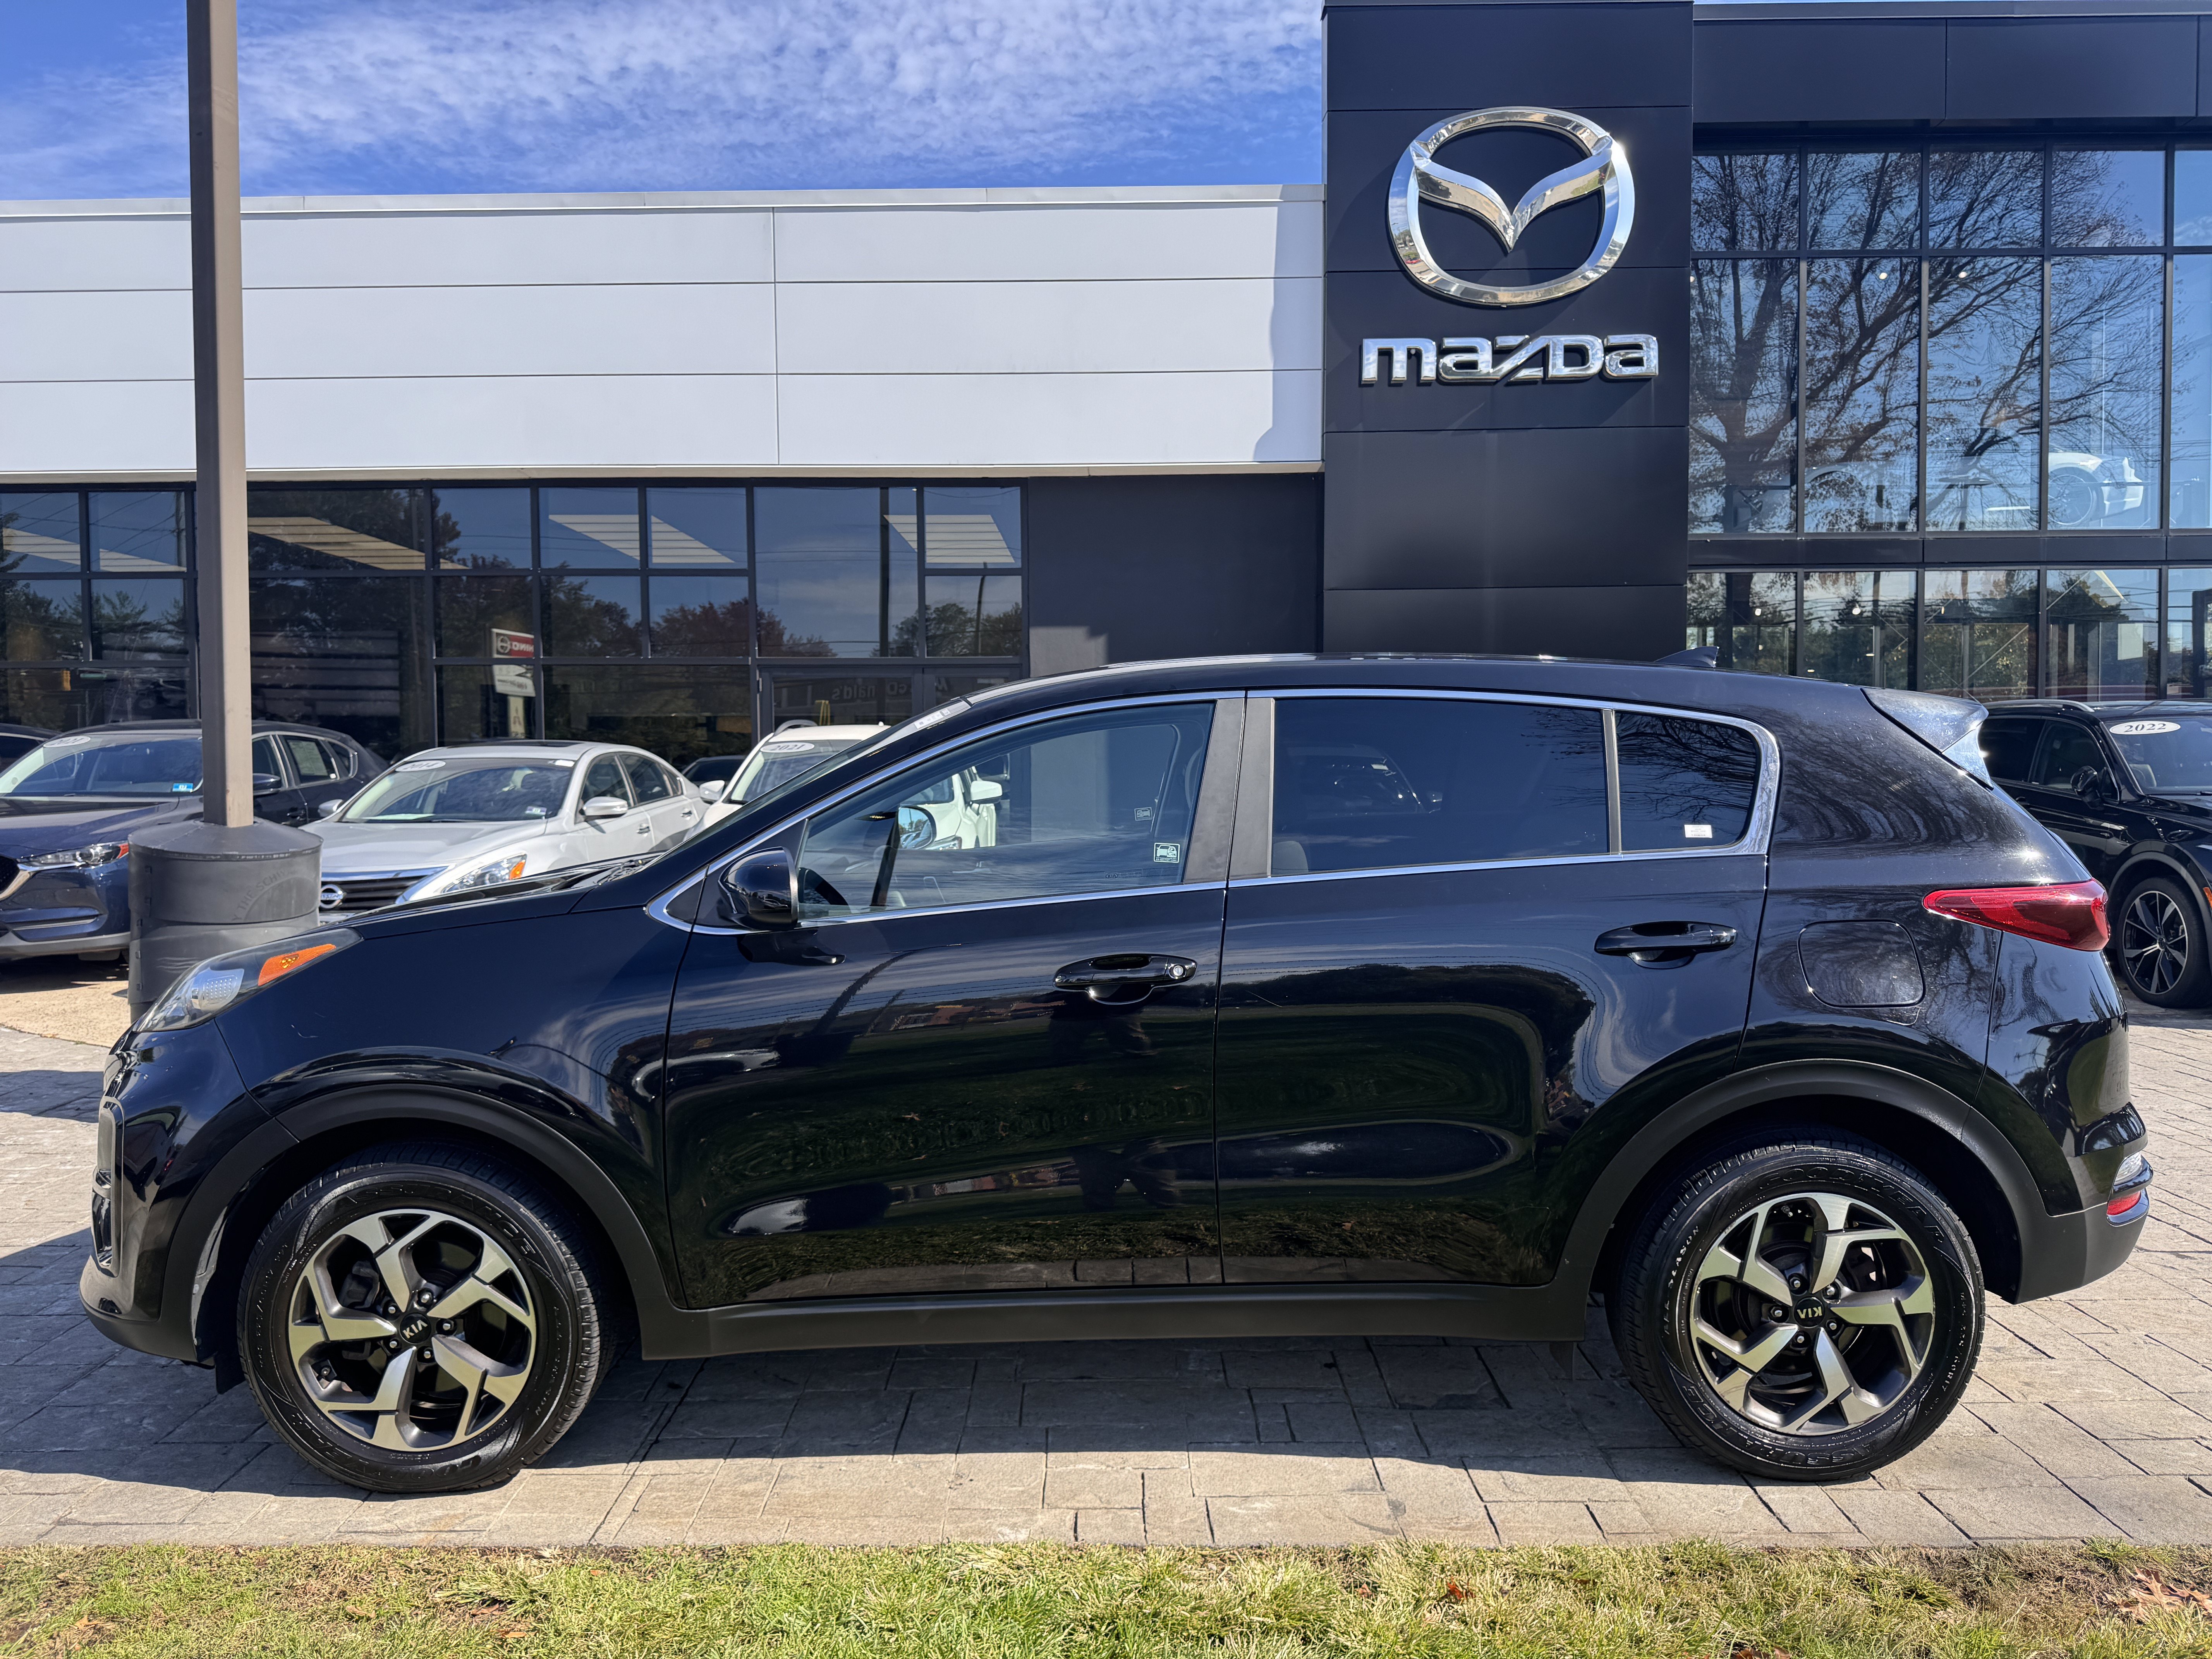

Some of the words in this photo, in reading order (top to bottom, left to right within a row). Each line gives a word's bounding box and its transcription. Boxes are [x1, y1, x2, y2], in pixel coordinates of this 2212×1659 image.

[2123, 723, 2166, 732] 2022
[237, 890, 254, 910] THE
[333, 1183, 538, 1255] ASSURANCE
[1797, 1306, 1822, 1319] KIA
[403, 1320, 428, 1338] KIA
[1682, 1386, 1877, 1465] ASSURANCE
